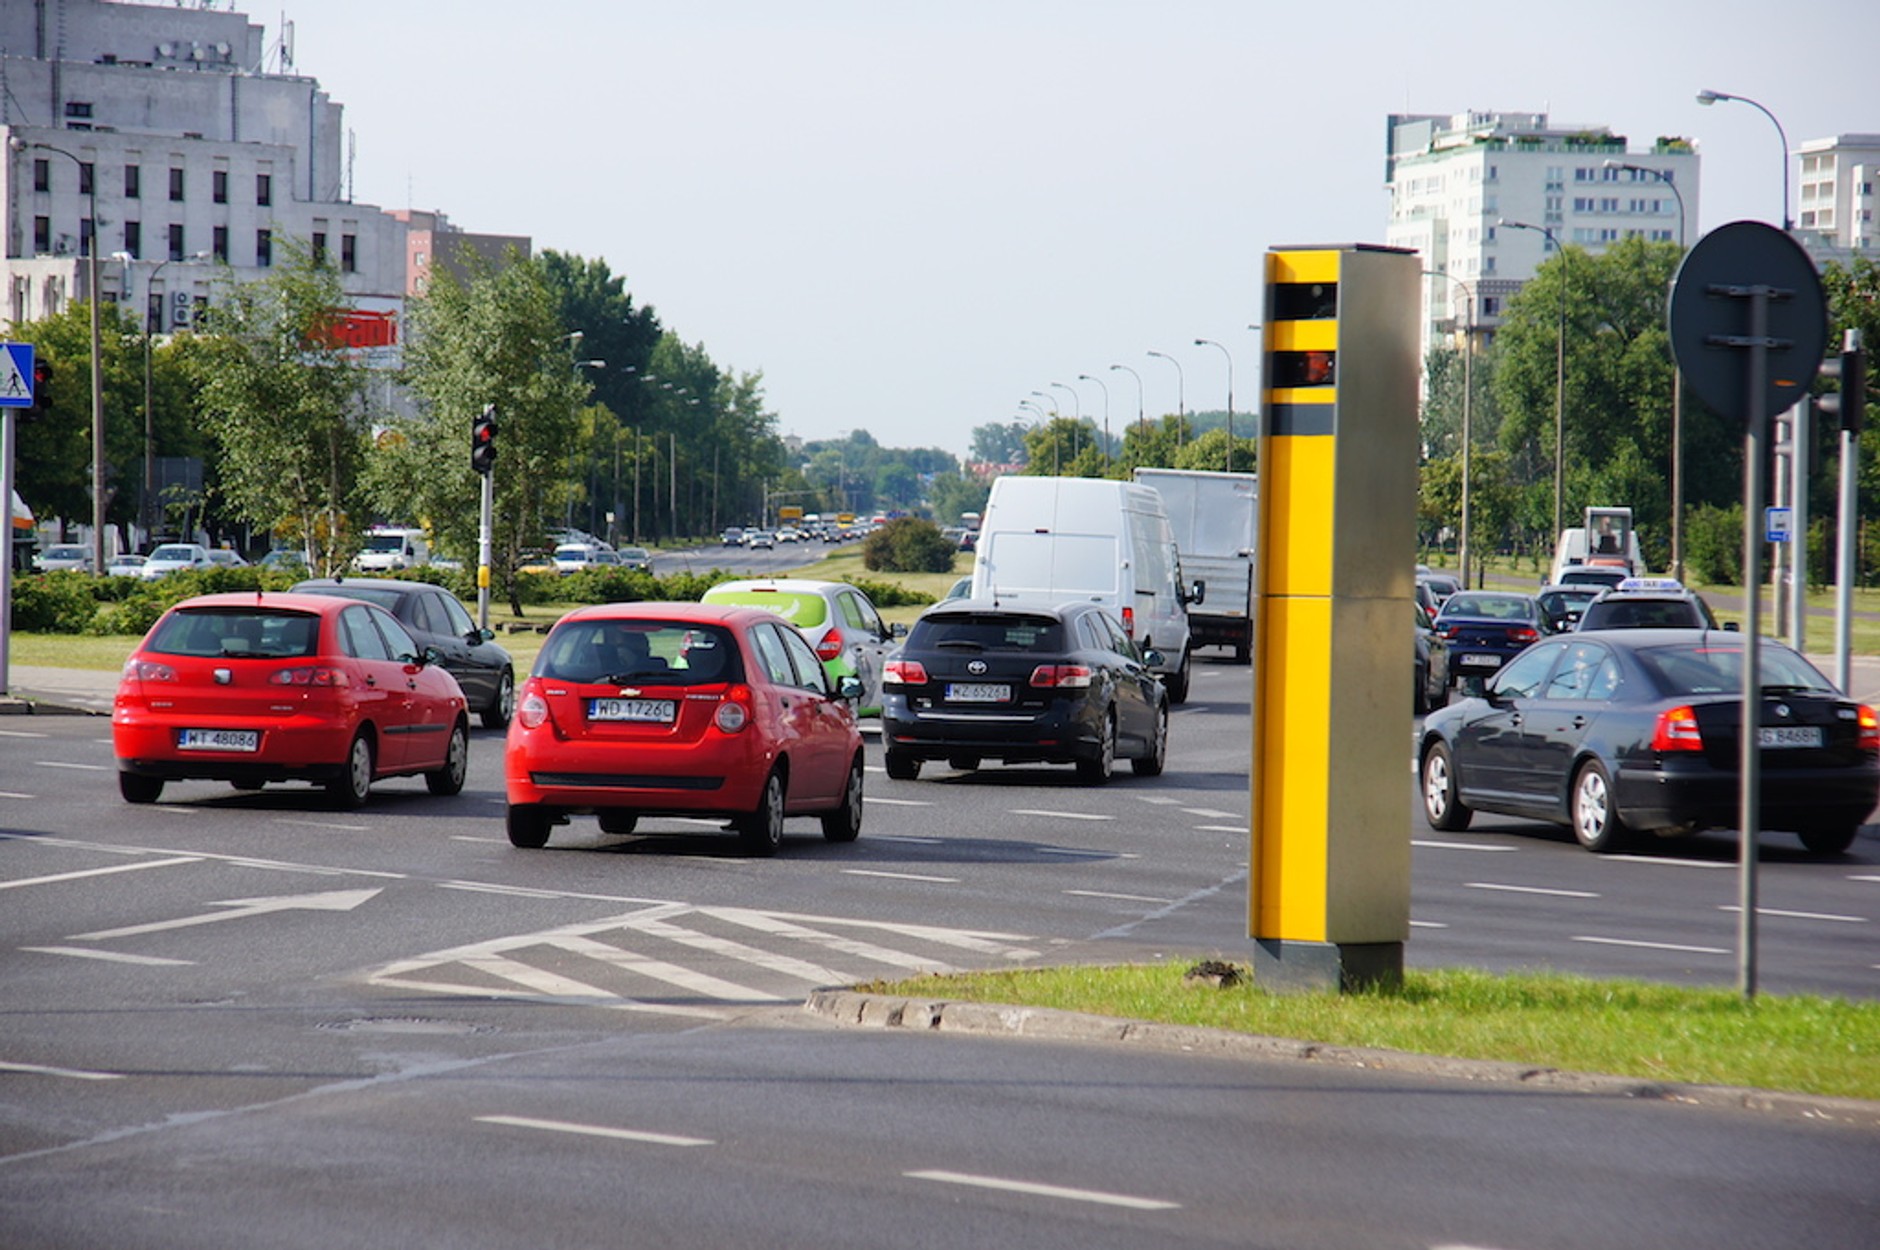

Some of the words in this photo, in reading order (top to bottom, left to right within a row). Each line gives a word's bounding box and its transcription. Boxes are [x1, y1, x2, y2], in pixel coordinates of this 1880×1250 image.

[599, 700, 620, 716] WD
[626, 701, 673, 717] 1726C
[188, 731, 207, 746] WT
[212, 733, 256, 747] 48086
